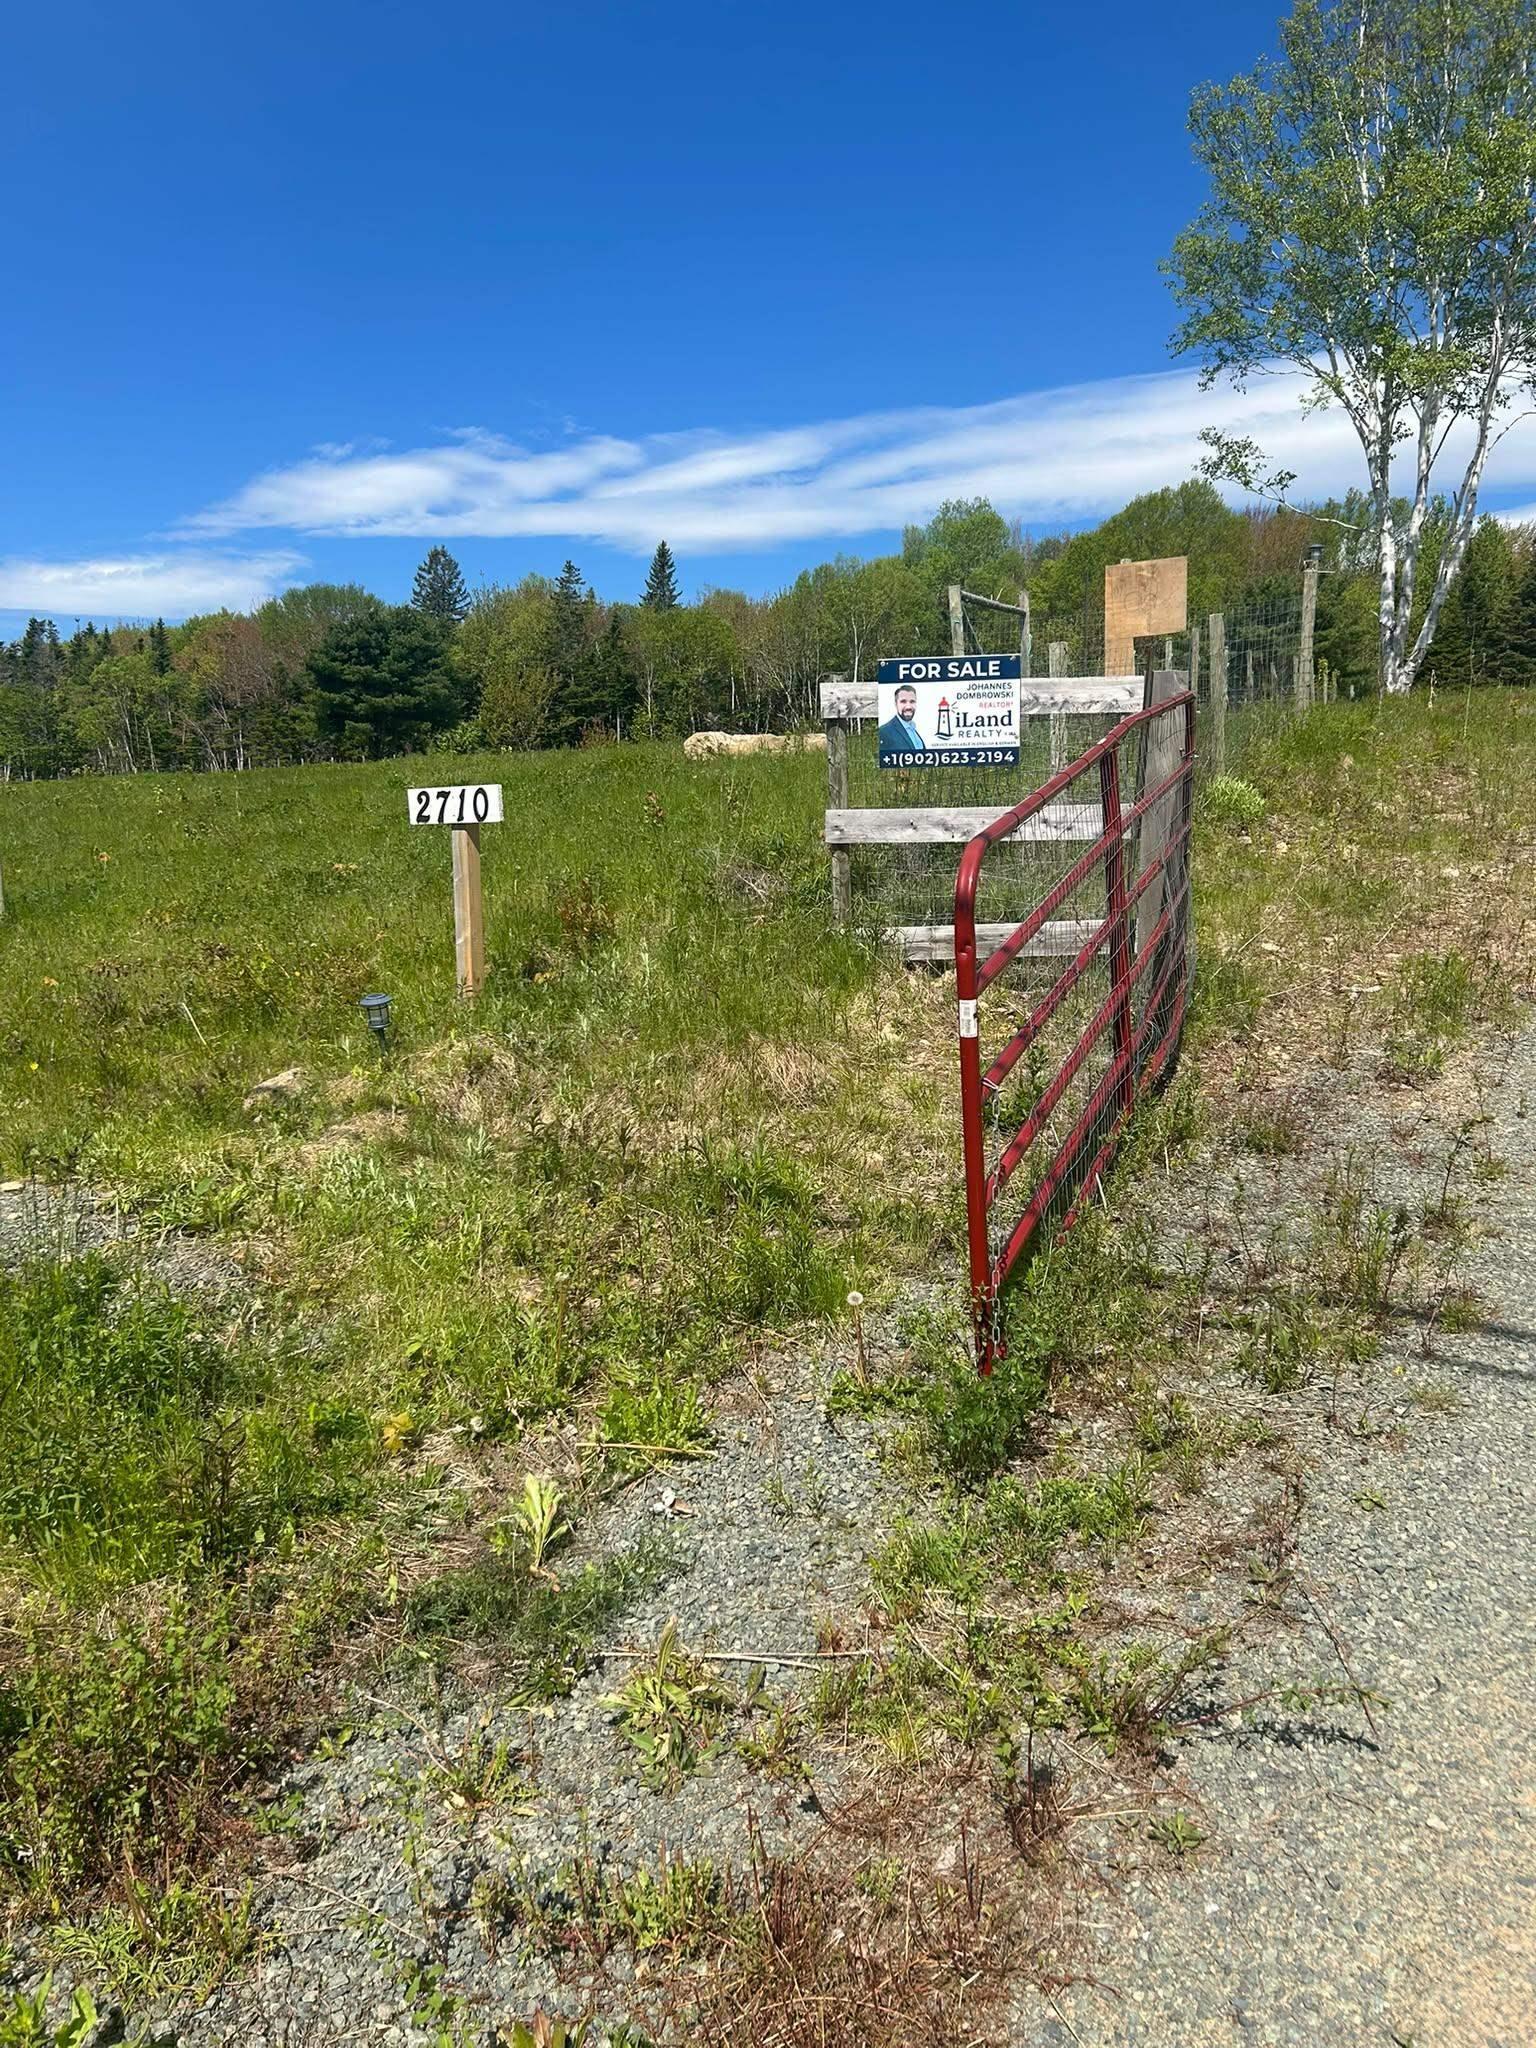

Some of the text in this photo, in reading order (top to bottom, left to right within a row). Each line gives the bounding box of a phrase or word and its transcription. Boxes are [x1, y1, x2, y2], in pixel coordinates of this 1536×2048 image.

[899, 660, 1001, 680] FOR SALE
[967, 682, 1013, 691] JOHANNES
[956, 691, 1014, 700] DOMBROWSKI
[955, 709, 1013, 728] iLand
[958, 729, 1002, 738] REALTY
[883, 751, 1015, 767] +1(902)623-2194
[416, 787, 489, 824] 2710
